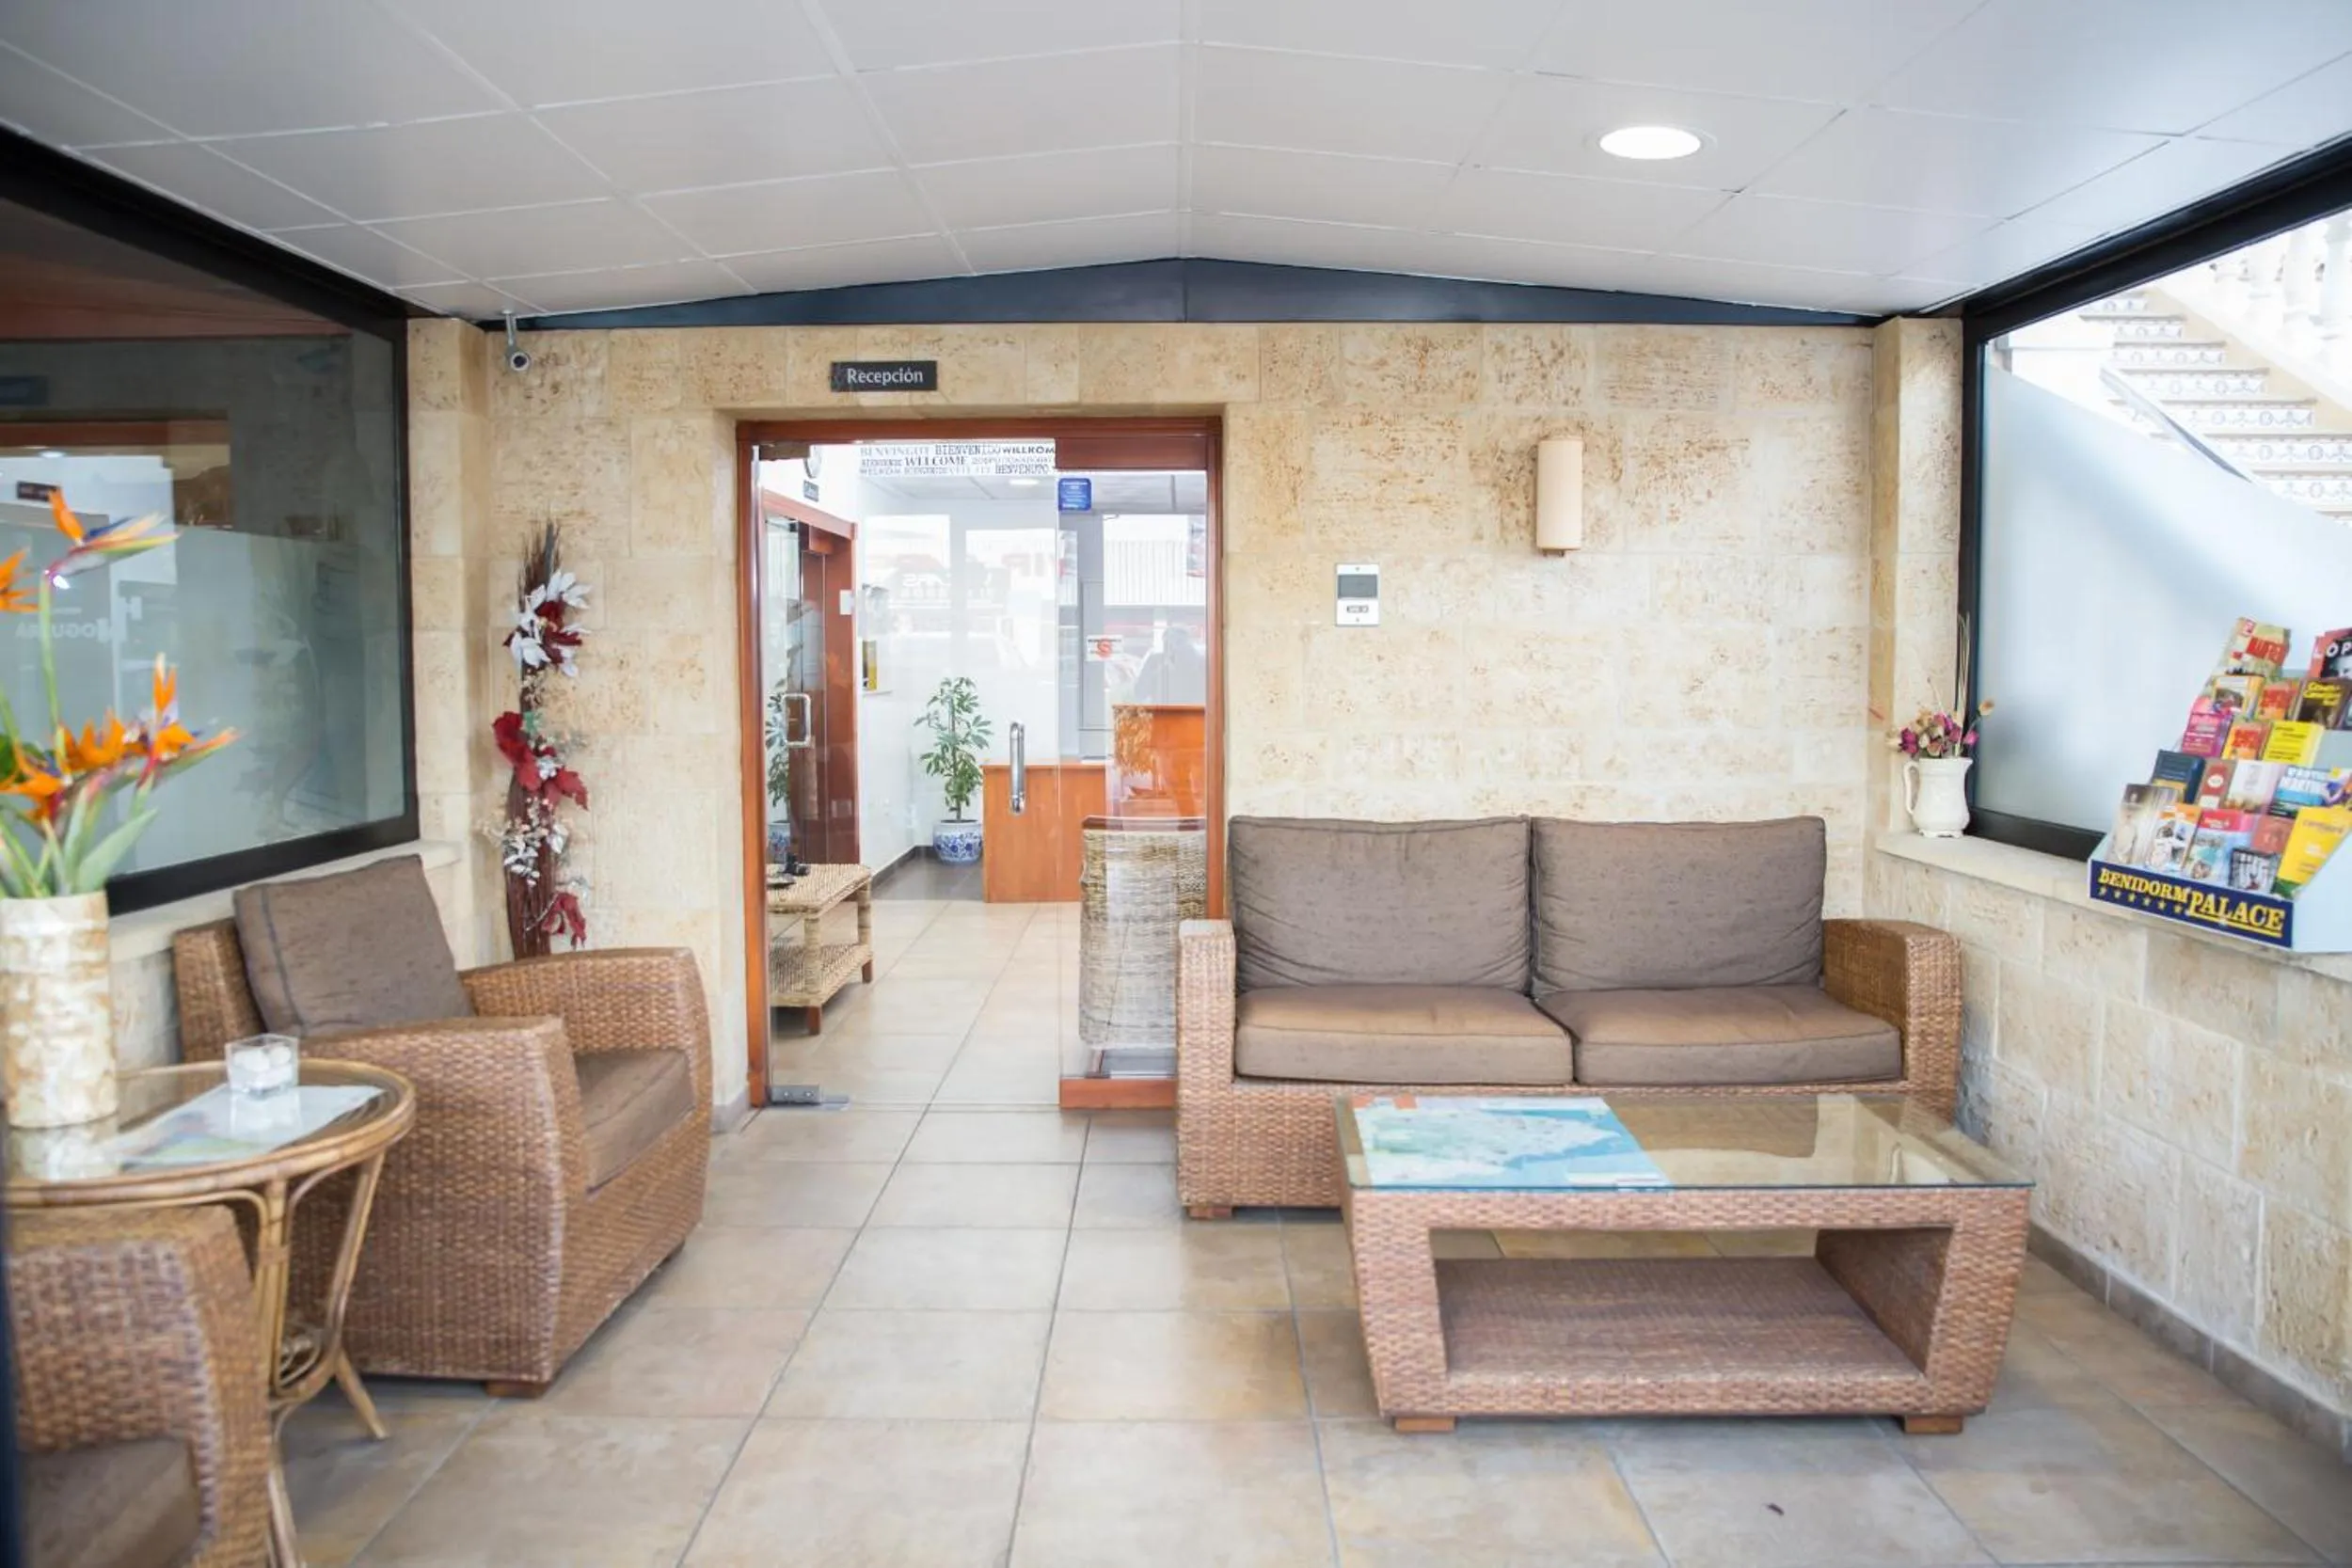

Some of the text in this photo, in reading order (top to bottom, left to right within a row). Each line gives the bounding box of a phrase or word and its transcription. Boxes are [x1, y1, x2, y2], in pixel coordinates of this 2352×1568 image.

[905, 456, 966, 466] WELCOME
[2097, 867, 2286, 932] BENIDORM PALACE
